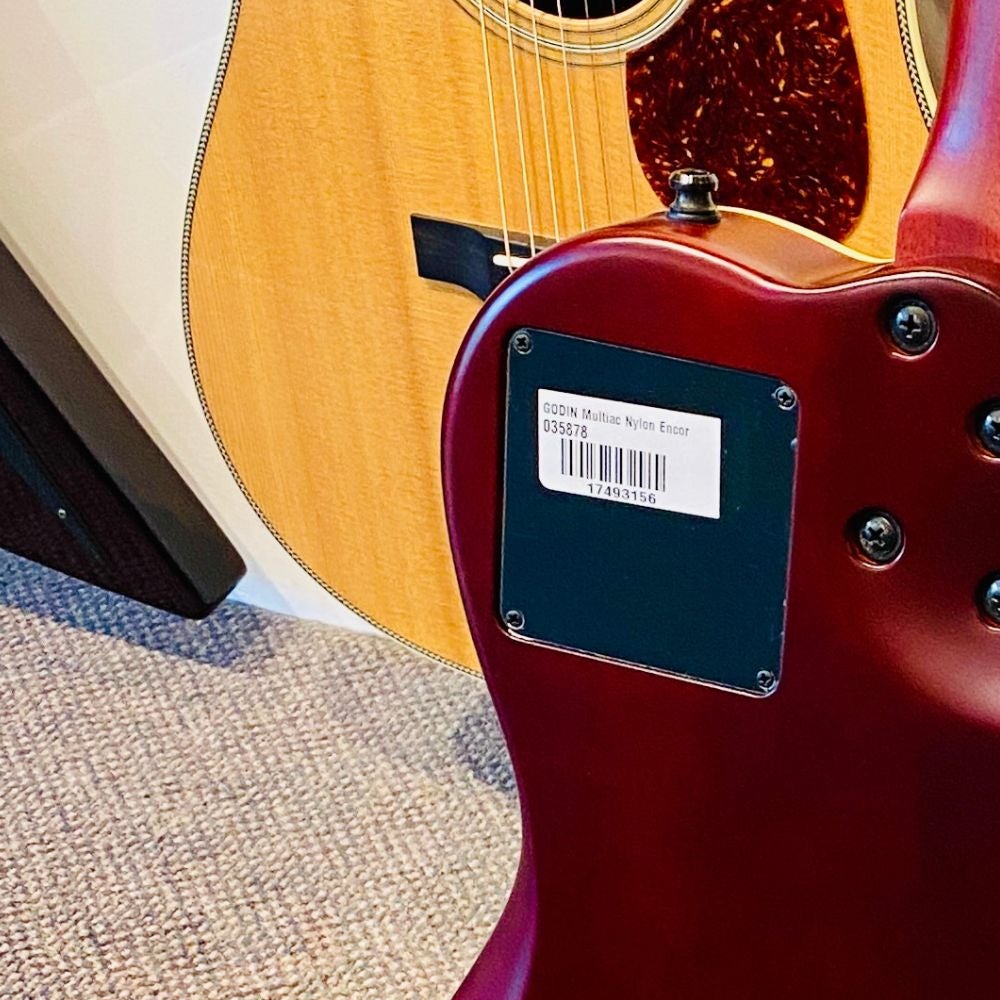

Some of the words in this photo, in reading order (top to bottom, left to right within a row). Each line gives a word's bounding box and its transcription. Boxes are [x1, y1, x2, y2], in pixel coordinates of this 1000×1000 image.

[543, 402, 578, 418] GODIN
[582, 408, 622, 426] Multiac
[625, 416, 655, 431] Nylon
[660, 421, 690, 436] Encor
[543, 419, 588, 439] 035878
[588, 483, 656, 504] 17493156
